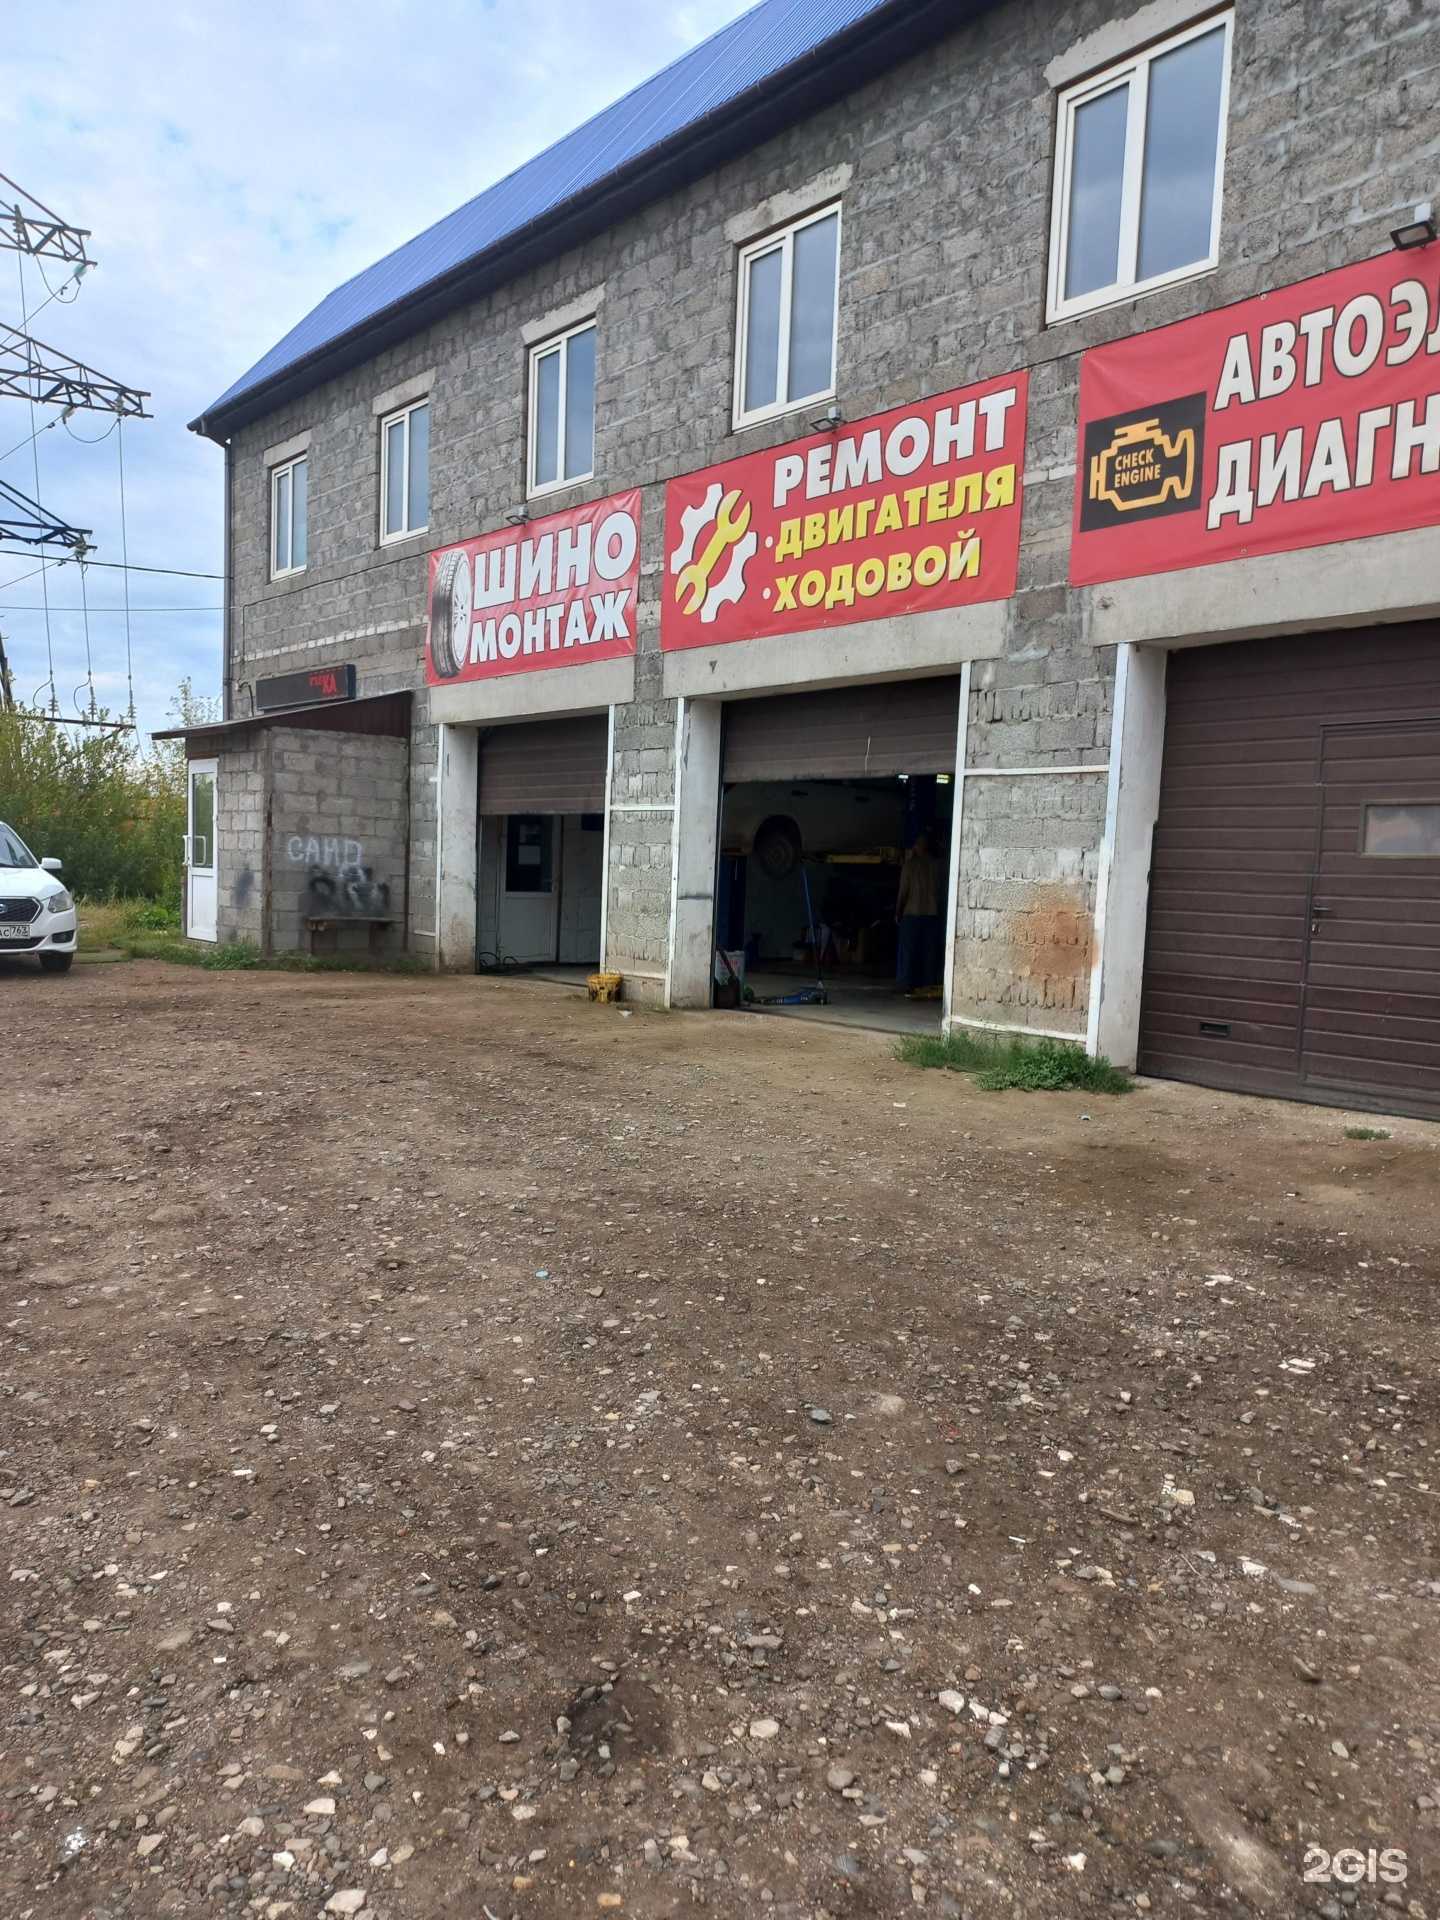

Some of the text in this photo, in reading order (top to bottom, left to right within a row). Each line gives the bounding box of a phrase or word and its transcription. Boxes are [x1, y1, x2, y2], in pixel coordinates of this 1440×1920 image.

[1212, 278, 1440, 412] АВТОЭ
[773, 387, 1016, 509] РЕМОНТ
[1114, 464, 1161, 488] ENGINE
[1115, 448, 1154, 471] CHECK
[775, 464, 1016, 562] ДВИГАТЕЛЯ
[473, 511, 637, 610] ШИНО
[773, 528, 981, 613] ХОДОВОЙ
[469, 588, 632, 665] МОНТАЖ
